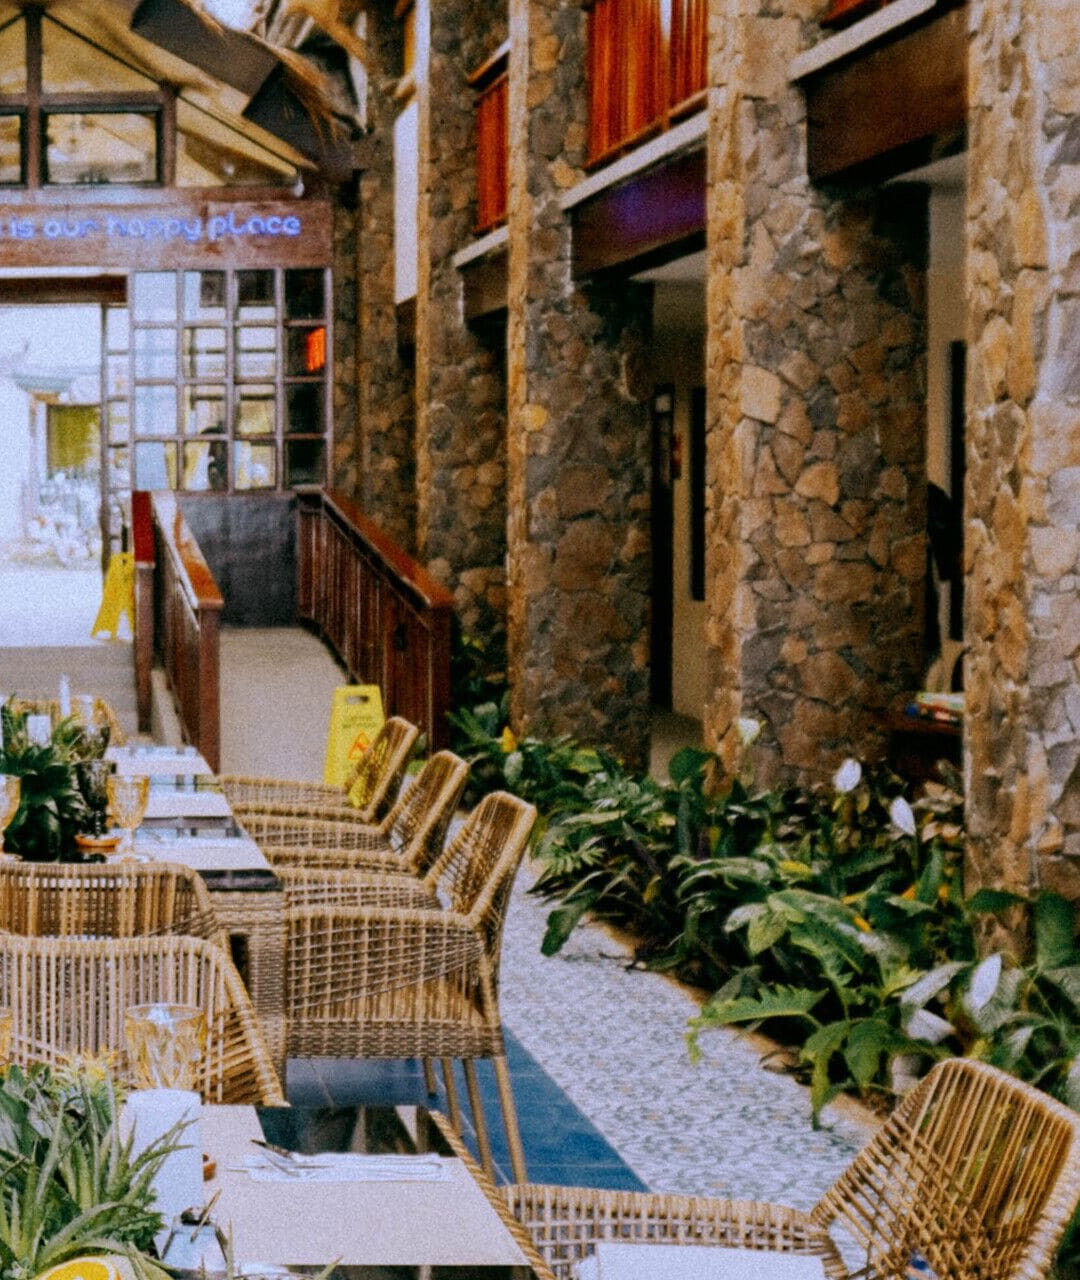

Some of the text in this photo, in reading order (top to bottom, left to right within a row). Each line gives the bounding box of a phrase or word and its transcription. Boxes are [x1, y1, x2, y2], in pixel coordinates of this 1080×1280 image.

[9, 214, 35, 239] is
[106, 214, 202, 242] happy
[207, 213, 302, 239] place
